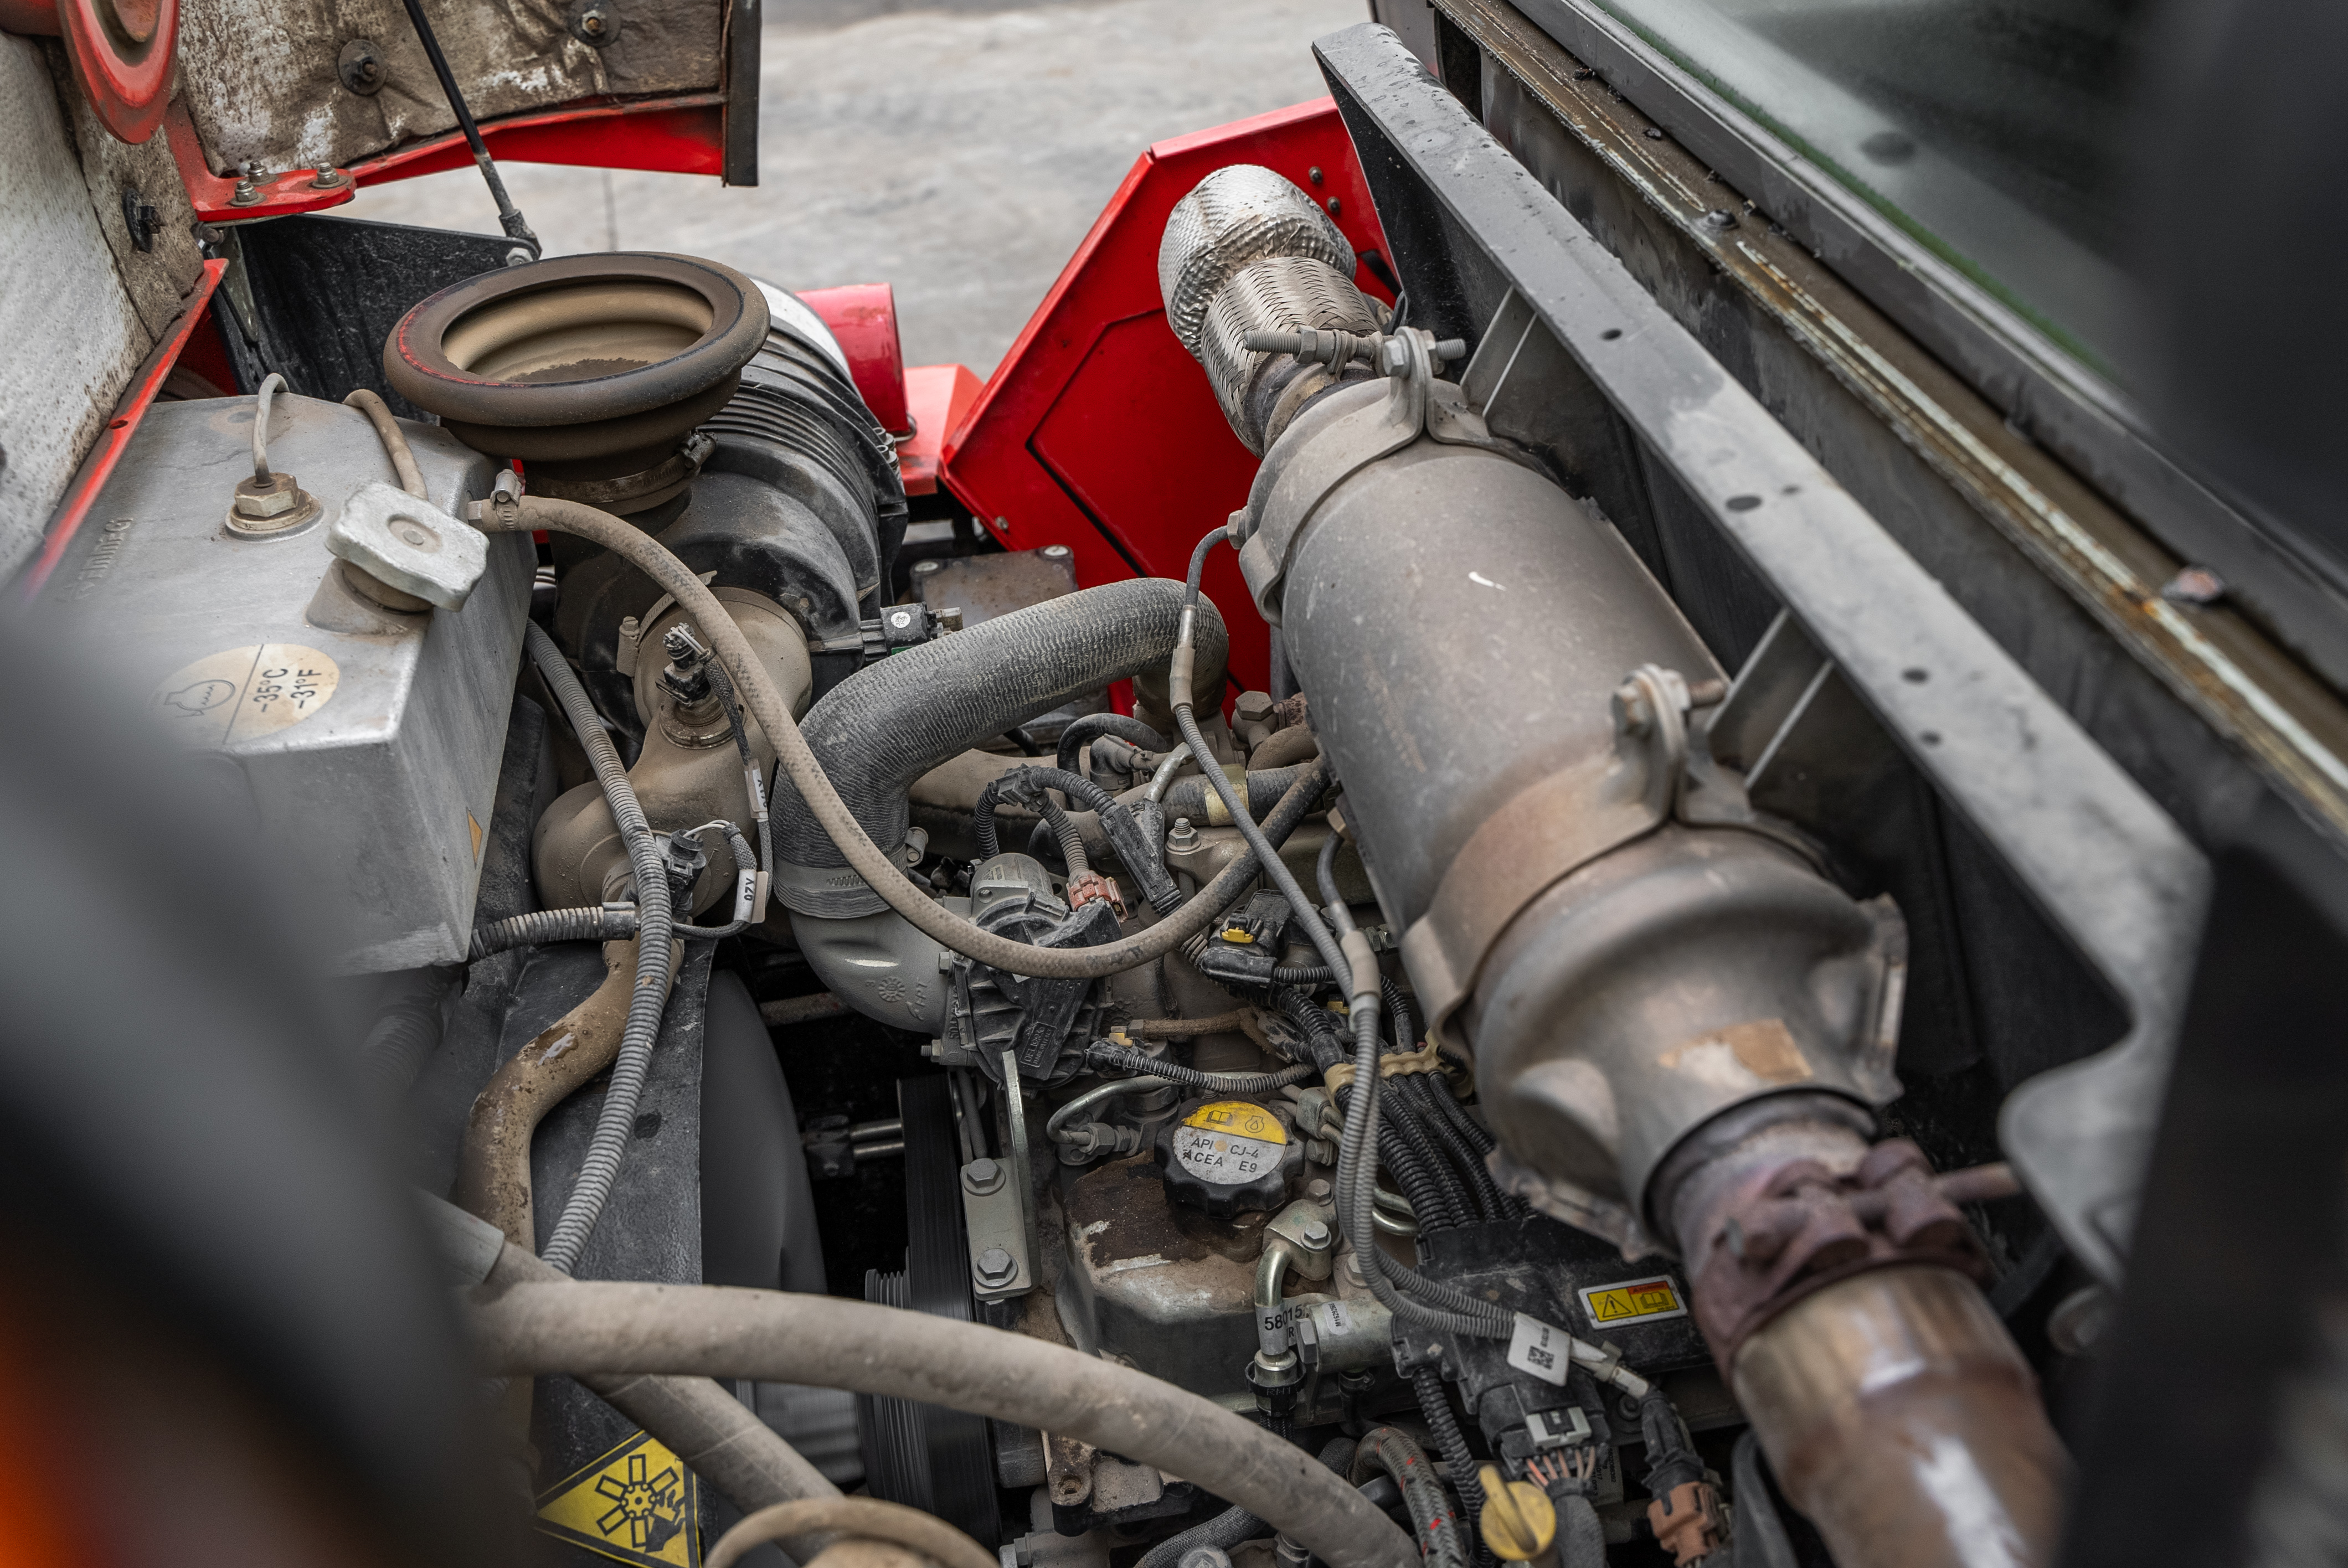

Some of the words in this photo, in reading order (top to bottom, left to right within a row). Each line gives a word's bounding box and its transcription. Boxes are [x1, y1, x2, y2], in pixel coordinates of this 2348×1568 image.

[1191, 1138, 1214, 1149] API
[1230, 1144, 1259, 1158] CJ-4
[1183, 1149, 1223, 1167] ACEA
[1238, 1160, 1258, 1173] E9
[1264, 1304, 1305, 1330] 58015
